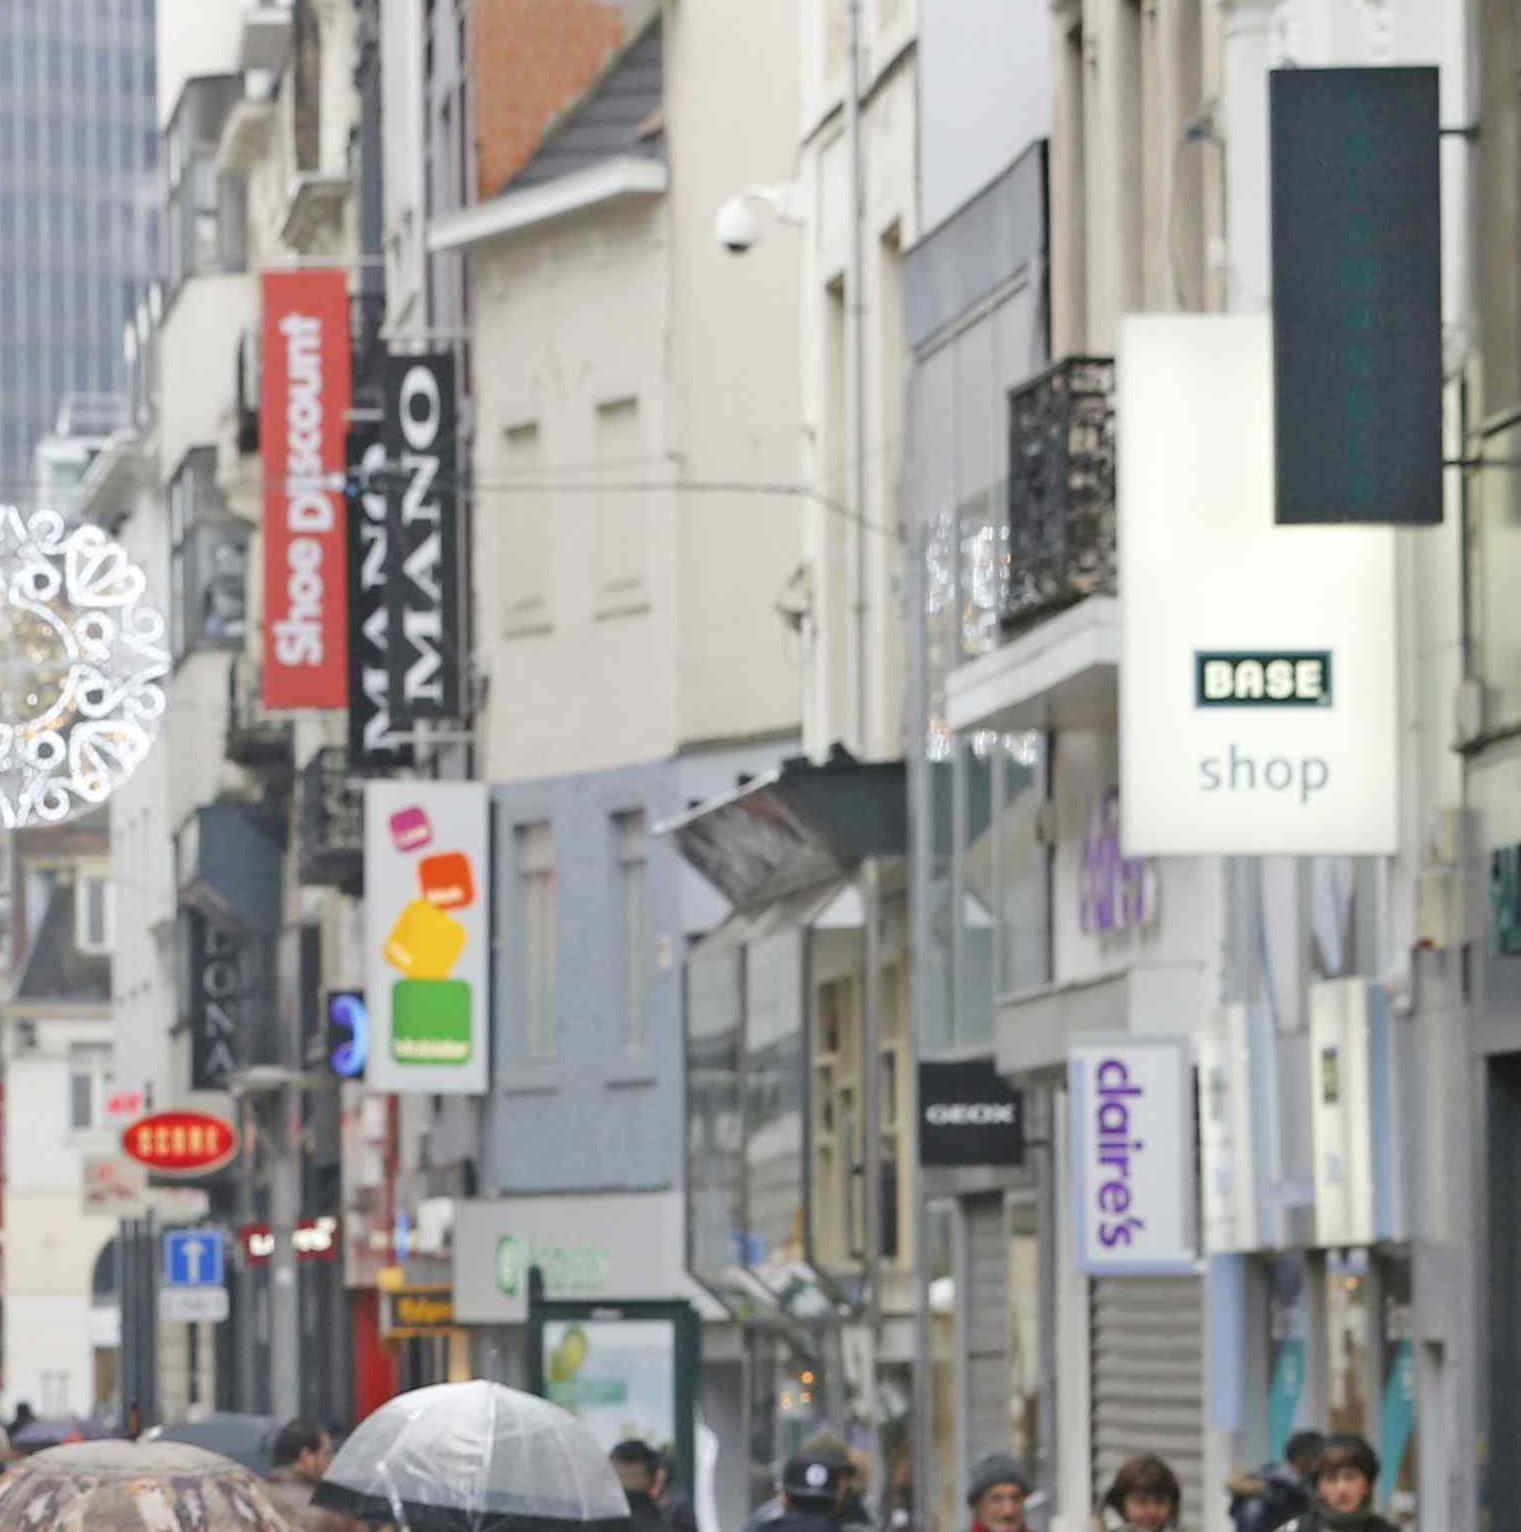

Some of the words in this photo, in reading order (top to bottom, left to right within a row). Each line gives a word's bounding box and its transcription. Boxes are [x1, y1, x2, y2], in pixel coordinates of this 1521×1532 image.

[398, 365, 444, 704] MANO
[273, 538, 324, 667] Shoe
[1203, 659, 1323, 700] BASE
[1199, 742, 1330, 806] shop
[924, 1103, 1016, 1125] GEOX
[1096, 1059, 1144, 1248] claire's
